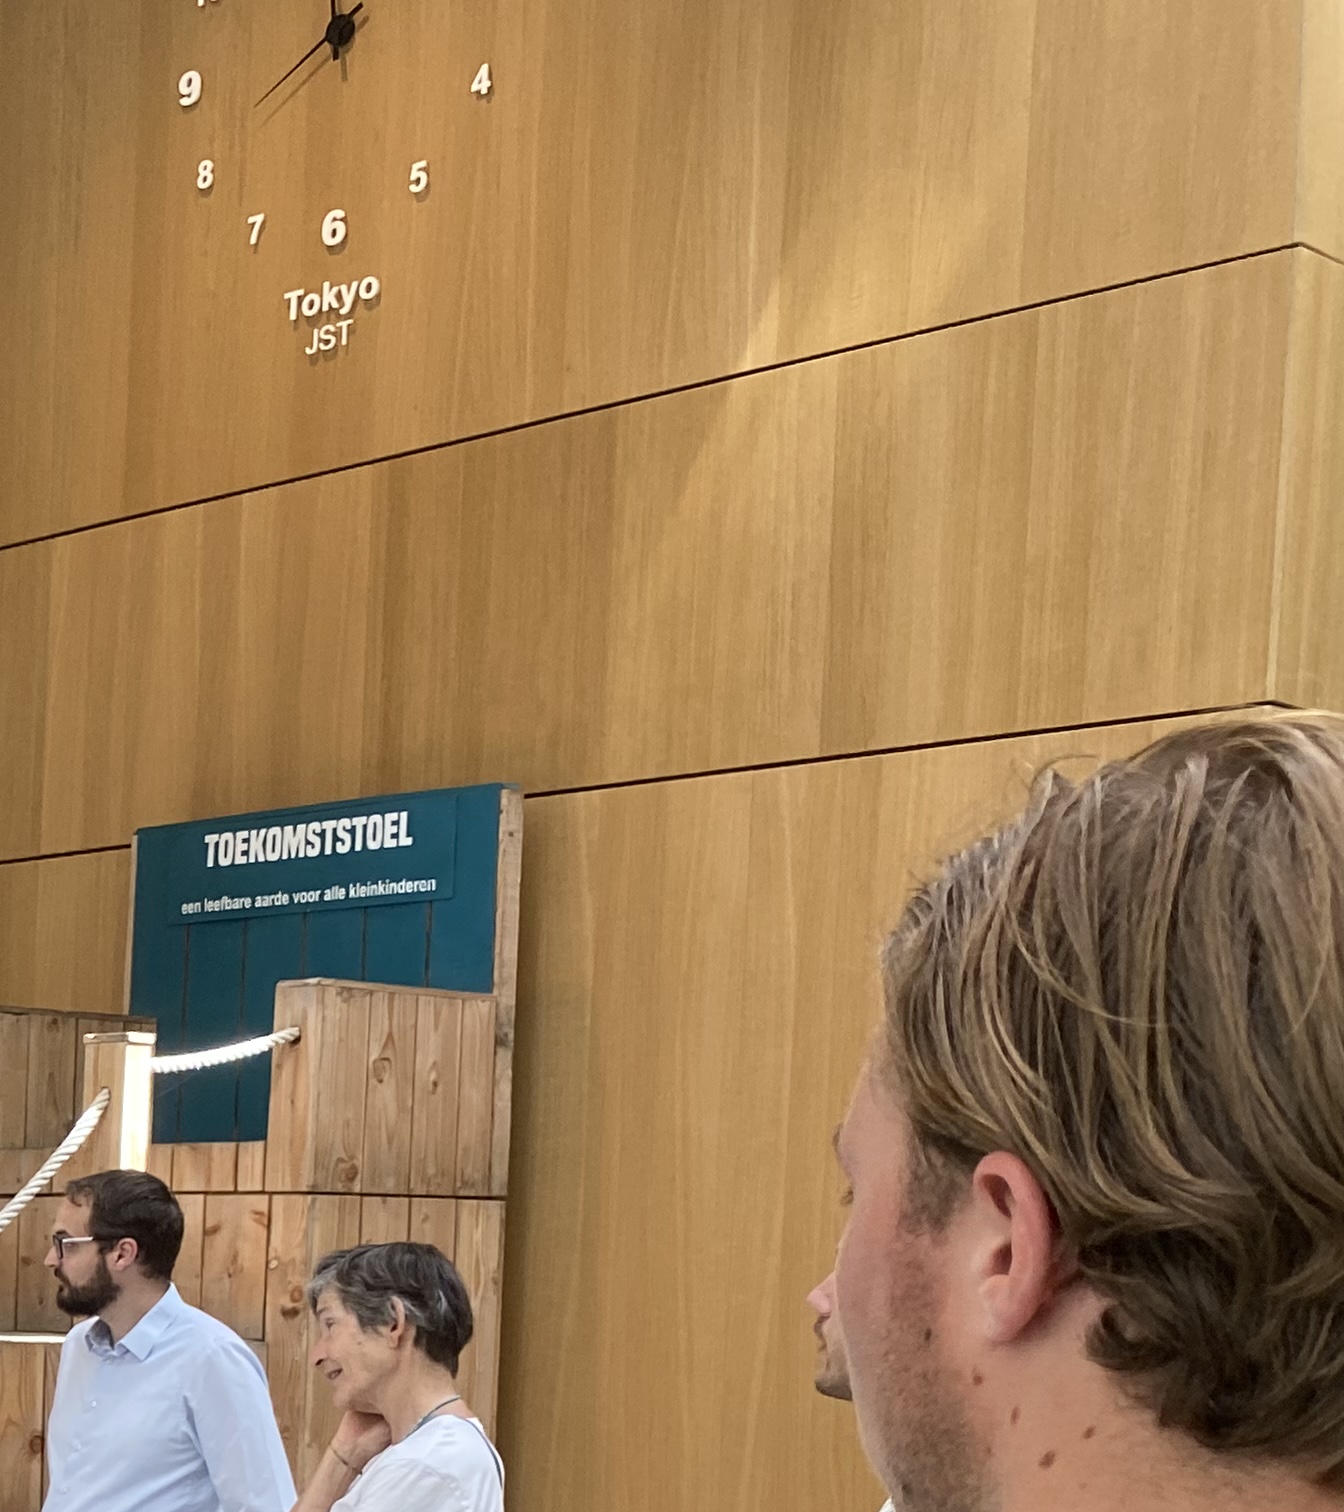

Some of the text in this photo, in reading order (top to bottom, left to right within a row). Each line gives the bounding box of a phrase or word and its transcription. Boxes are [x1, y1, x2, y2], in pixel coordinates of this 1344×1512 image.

[178, 70, 202, 107] 9
[470, 63, 492, 95] 4
[196, 159, 214, 190] 8
[408, 160, 428, 193] 5
[247, 213, 265, 245] 7
[321, 209, 346, 246] 6
[284, 275, 380, 321] Tokyo
[305, 319, 354, 356] JST
[204, 811, 413, 868] TOEKOMSTSTOEL
[181, 878, 437, 915] een leefbare aarde voor alle kleinkinderen
